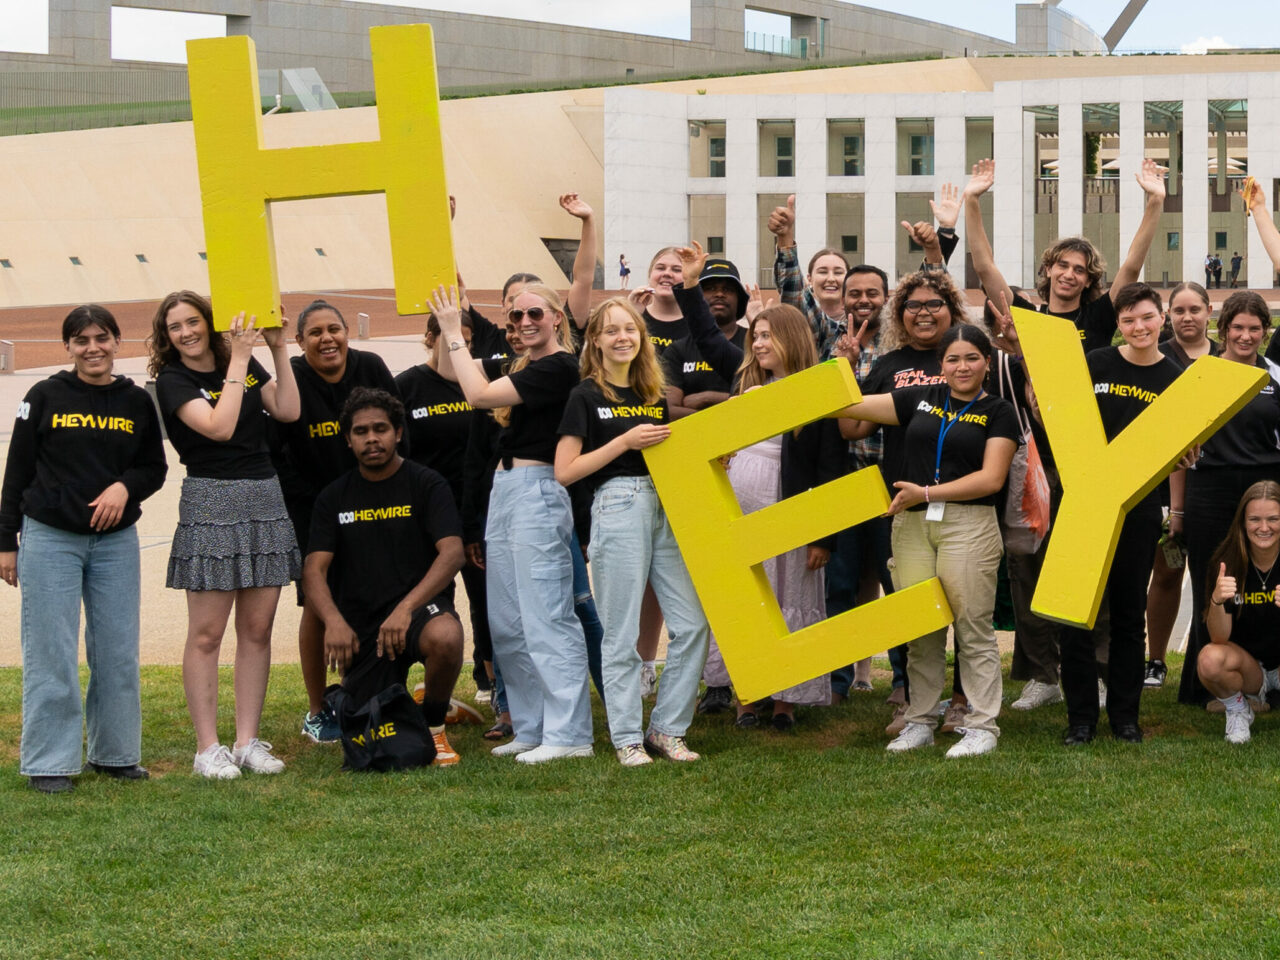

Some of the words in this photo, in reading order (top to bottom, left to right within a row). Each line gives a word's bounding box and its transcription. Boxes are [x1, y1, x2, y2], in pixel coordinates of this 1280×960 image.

[893, 369, 927, 382] TRAIL
[1109, 382, 1159, 403] HEYWIR
[428, 401, 473, 416] HEYWI
[612, 405, 664, 420] HEYWIRE
[52, 413, 135, 434] HEYWIRE
[354, 505, 412, 522] HEYWIRE
